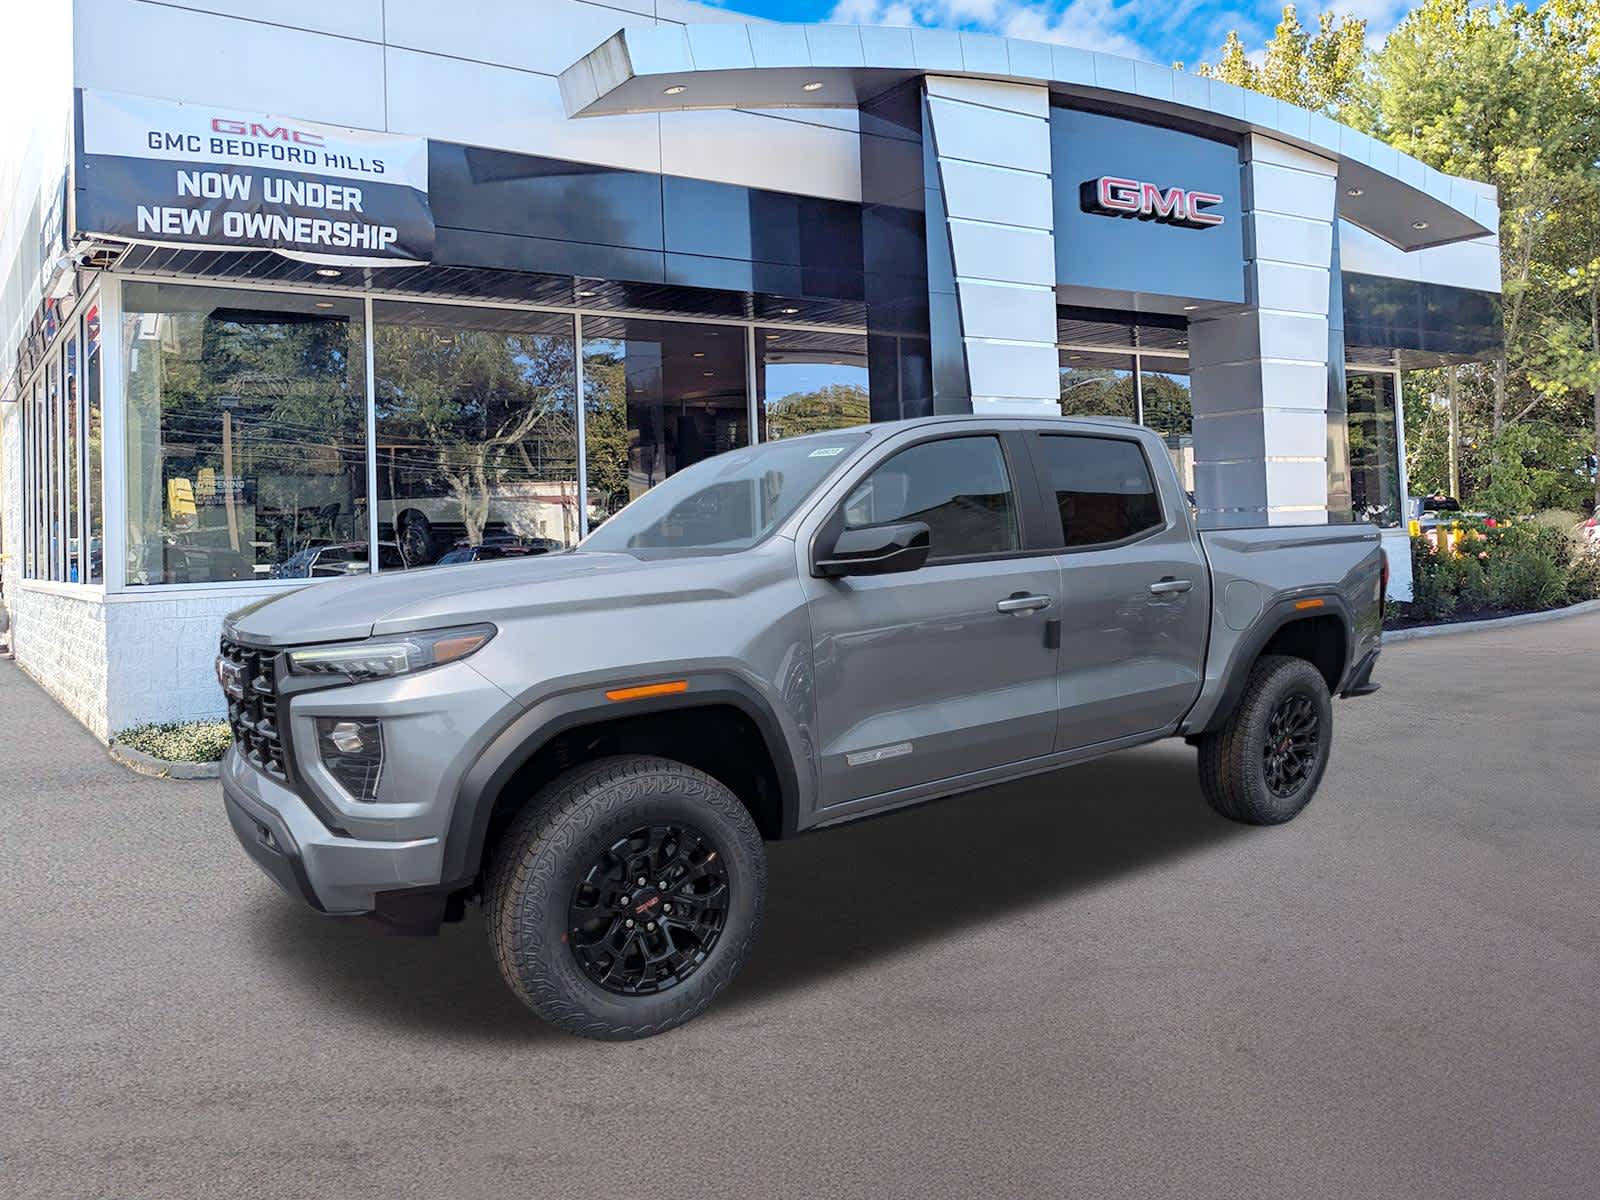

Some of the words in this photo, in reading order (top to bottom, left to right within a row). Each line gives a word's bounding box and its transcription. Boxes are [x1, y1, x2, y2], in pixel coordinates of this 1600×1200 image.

[148, 131, 201, 153] GMC
[209, 138, 316, 165] BEDFORD
[324, 152, 385, 174] HILLS
[211, 118, 326, 148] GMC
[177, 170, 252, 201] NOW
[263, 177, 364, 213] UNDER
[1097, 175, 1225, 225] GMC
[137, 205, 211, 236] NEW
[223, 211, 399, 250] OWNERSHIP
